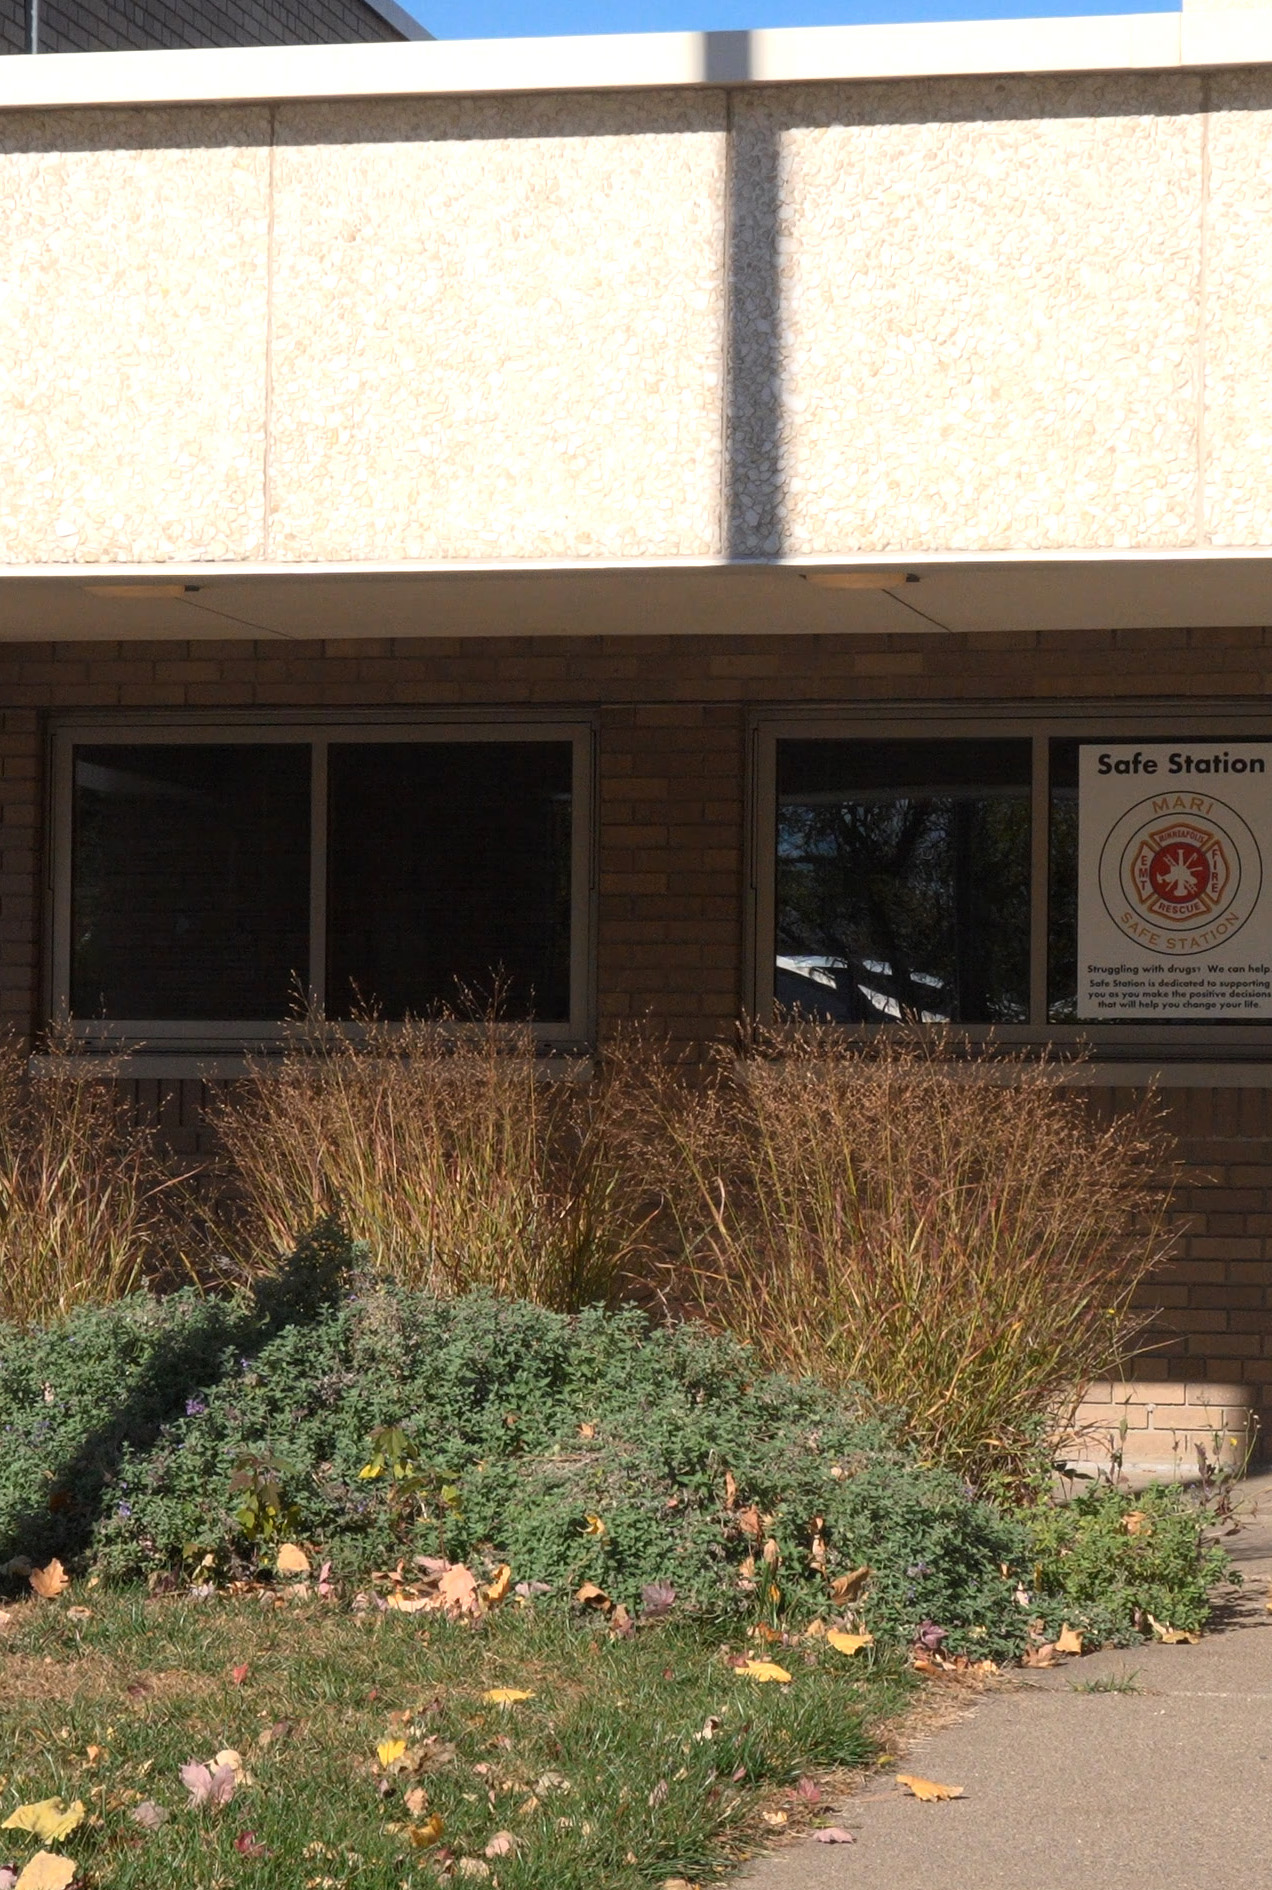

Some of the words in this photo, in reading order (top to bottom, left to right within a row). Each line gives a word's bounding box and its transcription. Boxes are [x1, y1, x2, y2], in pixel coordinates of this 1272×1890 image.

[1097, 752, 1158, 775] Safe
[1168, 752, 1266, 774] Station
[1152, 795, 1215, 815] MARI
[1158, 829, 1206, 844] MINNEAPOLIS
[1138, 855, 1149, 891] EMT
[1211, 848, 1220, 893] FIRE
[1158, 902, 1201, 914] RESCUE
[1120, 911, 1159, 946] SAFE
[1166, 911, 1240, 950] STATION
[1087, 964, 1139, 976] Struggling
[1142, 964, 1164, 973] with
[1167, 964, 1202, 976] drugs?
[1208, 965, 1225, 973] We
[1089, 979, 1110, 988] Safe
[1113, 979, 1146, 988] Station
[1148, 979, 1156, 988] is
[1158, 979, 1205, 988] dedicated
[1207, 979, 1217, 988] to
[1219, 979, 1271, 991] supporting
[1087, 991, 1106, 1001] you
[1108, 991, 1120, 999] as
[1122, 991, 1139, 1001] you
[1142, 990, 1169, 999] make
[1171, 990, 1187, 999] the
[1189, 990, 1227, 1001] positive
[1229, 990, 1272, 999] decisions
[1098, 1000, 1116, 1009] that
[1119, 1000, 1136, 1009] will
[1139, 1000, 1160, 1011] help
[1162, 1002, 1180, 1011] you
[1183, 1000, 1217, 1011] change
[1219, 1002, 1242, 1011] your
[1244, 1000, 1262, 1009] life.
